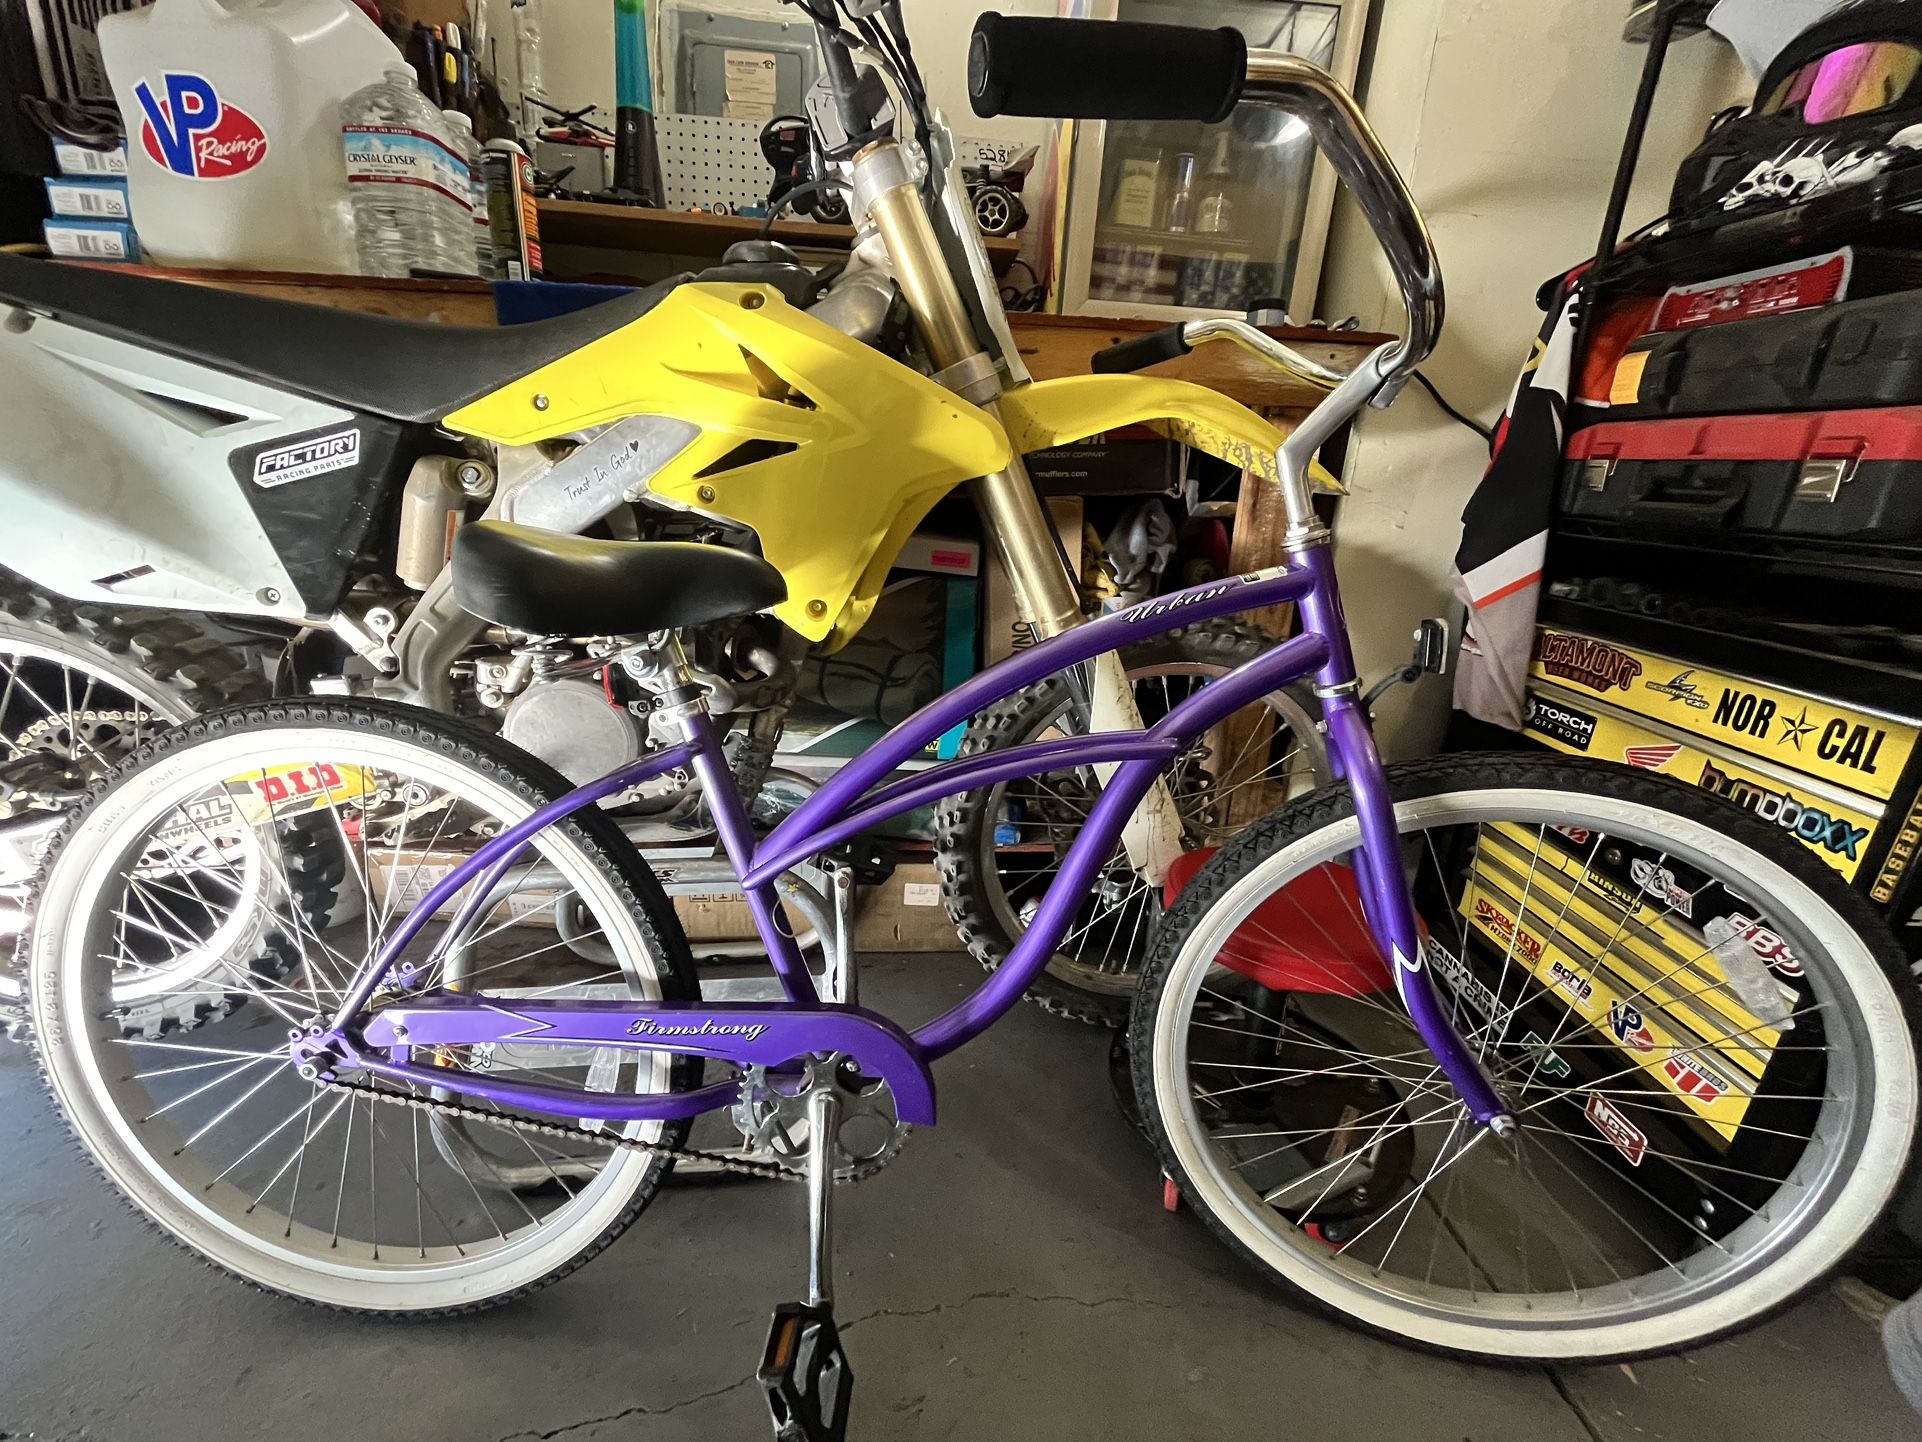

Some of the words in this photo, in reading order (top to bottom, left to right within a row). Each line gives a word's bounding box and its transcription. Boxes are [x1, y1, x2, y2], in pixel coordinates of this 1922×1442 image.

[135, 74, 219, 177] VP
[198, 134, 266, 168] Racing
[347, 153, 382, 163] CRYSTAL
[382, 154, 417, 166] GEYSER
[260, 434, 355, 474] FACTORY
[275, 467, 311, 482] RACING
[564, 476, 591, 501] Trust
[593, 466, 608, 482] In
[610, 446, 633, 470] God
[1120, 584, 1237, 623] Urban
[1647, 682, 1703, 702] SCORPION
[1534, 718, 1553, 730] OFF
[1558, 727, 1587, 744] ROAD
[1539, 704, 1594, 734] TORCH
[1712, 688, 1777, 739] NOR
[1817, 718, 1887, 775] CAL
[1429, 939, 1493, 1004] CANNABIS
[626, 1017, 771, 1042] Firmstrong
[1611, 999, 1643, 1041] VP
